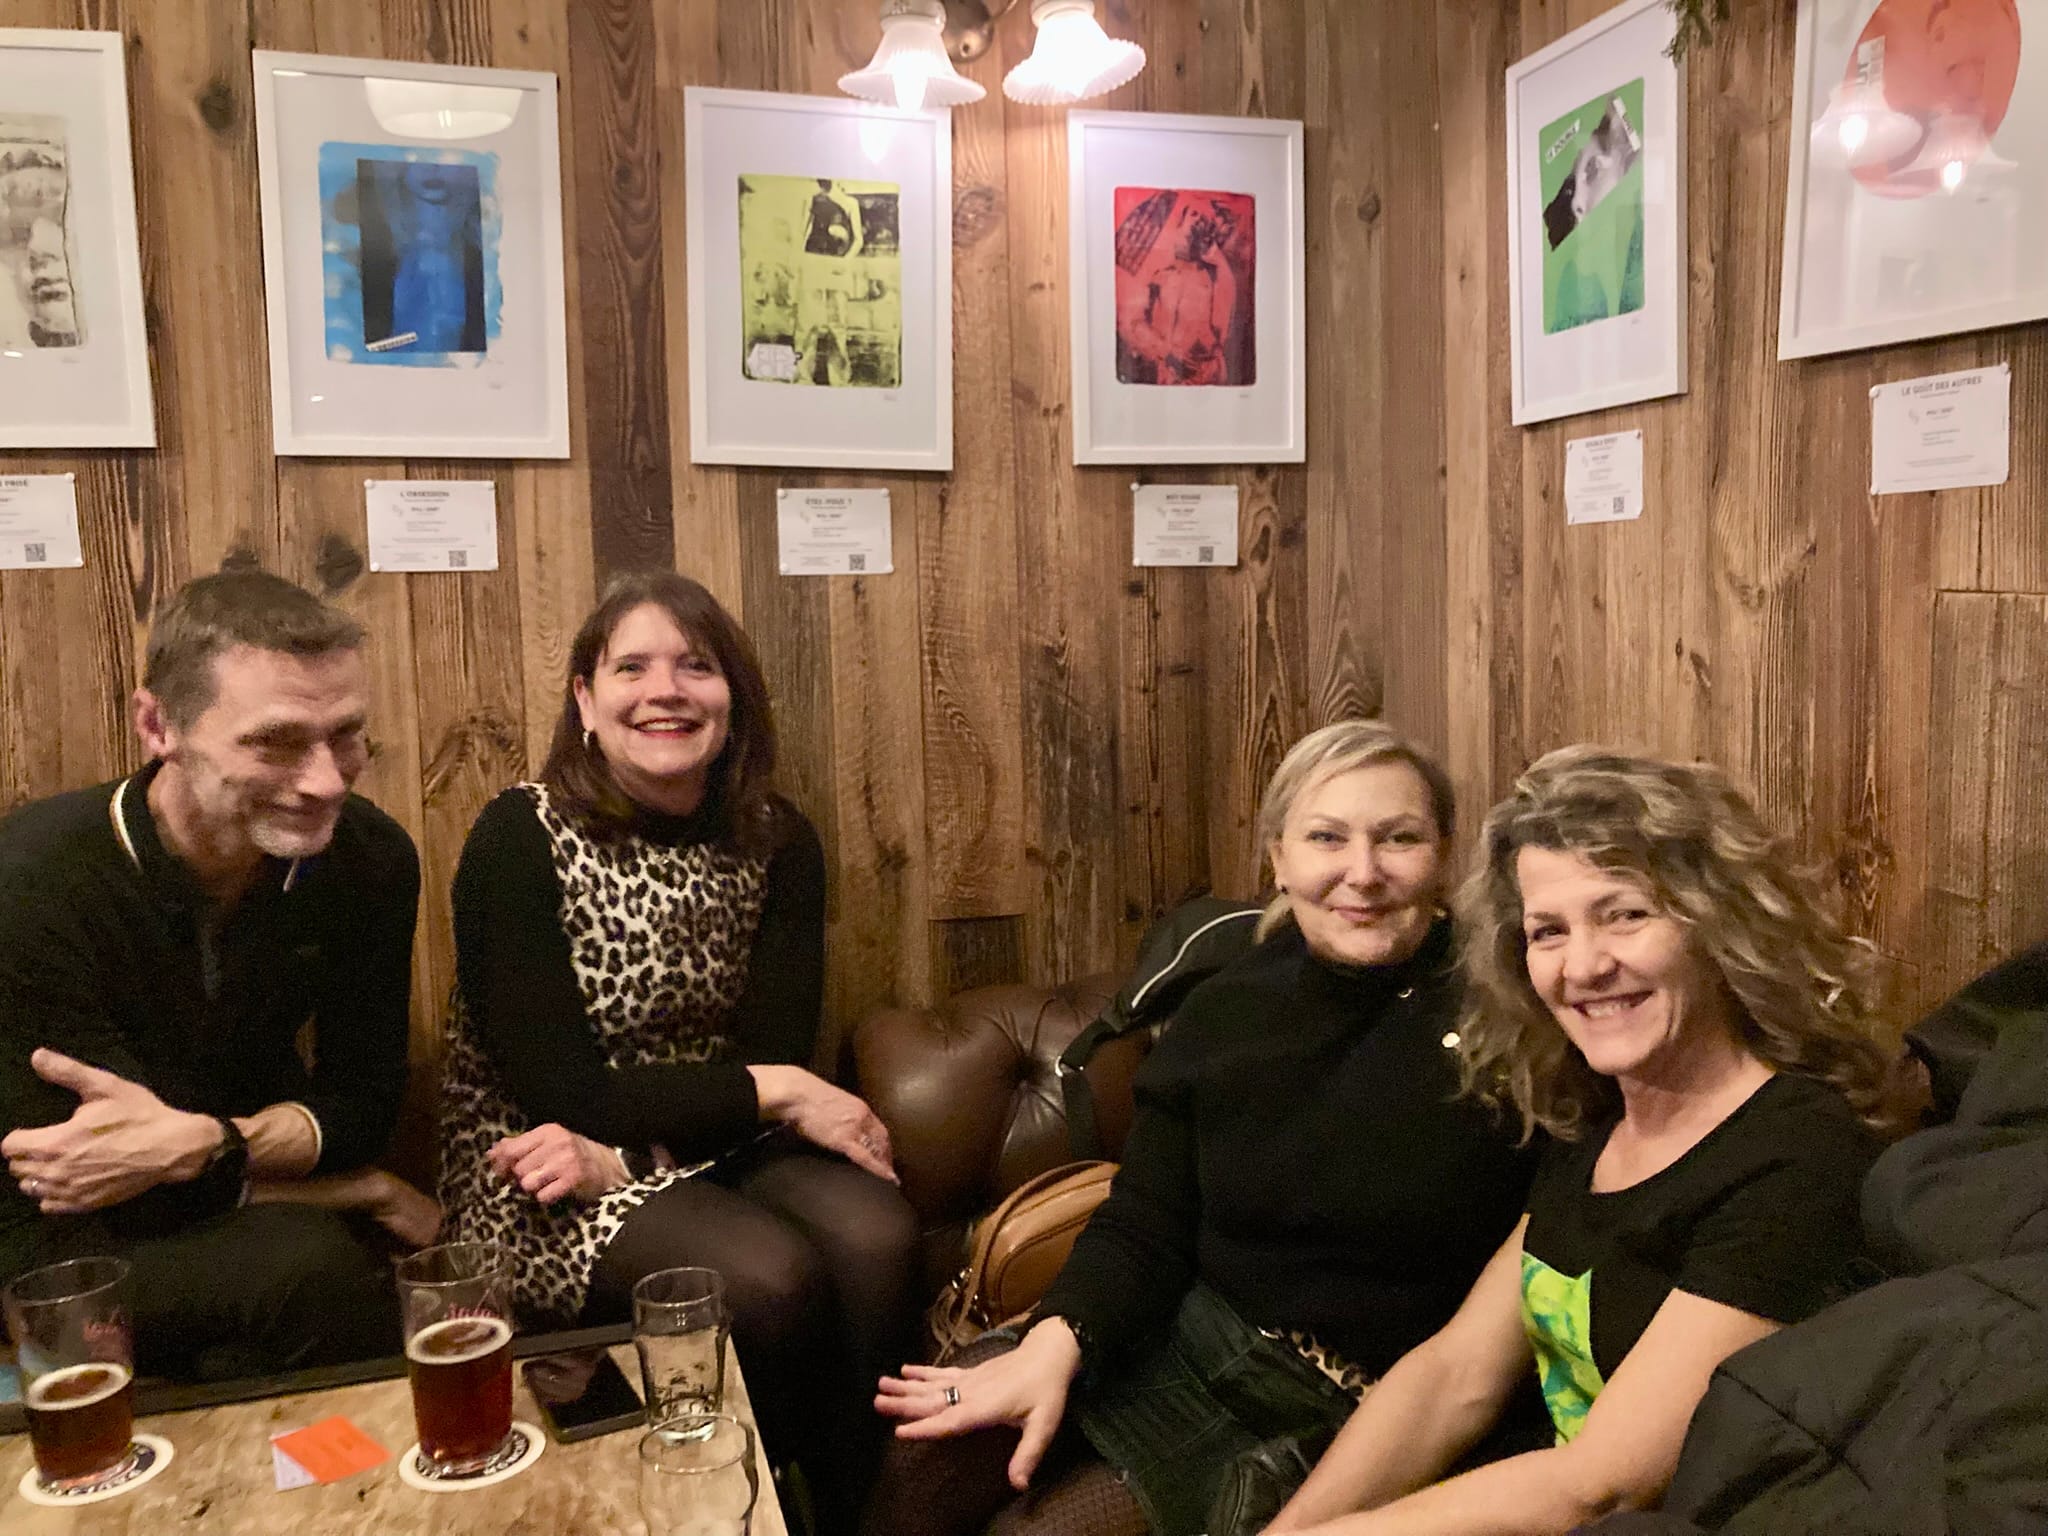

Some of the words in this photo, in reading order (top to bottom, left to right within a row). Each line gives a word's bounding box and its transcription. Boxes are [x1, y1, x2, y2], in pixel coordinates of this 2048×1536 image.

[1902, 386, 1911, 396] LE
[1935, 381, 1949, 391] DES
[1952, 376, 1983, 388] AUTRES
